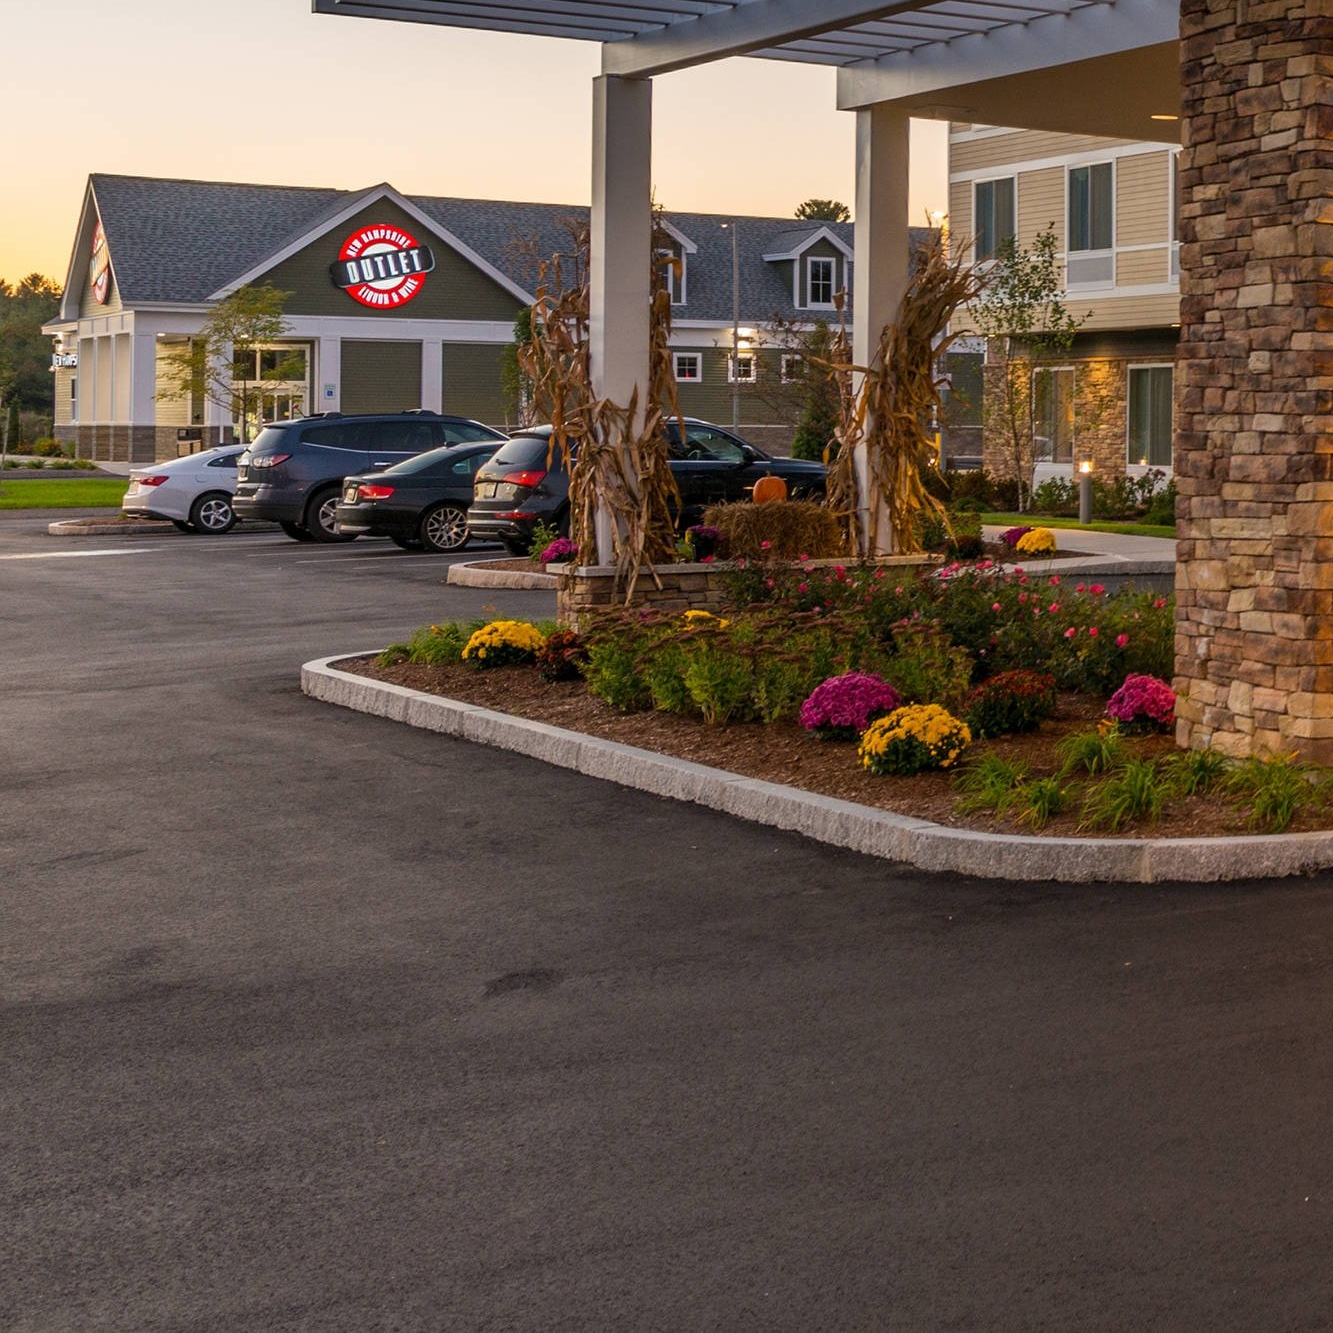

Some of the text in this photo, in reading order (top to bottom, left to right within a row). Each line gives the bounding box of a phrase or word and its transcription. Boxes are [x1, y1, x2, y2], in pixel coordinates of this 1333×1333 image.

[346, 229, 412, 257] NEW HAMPSHIRE
[346, 249, 422, 284] OUTLET
[358, 286, 390, 305] LIQUOR
[398, 278, 419, 298] WINE
